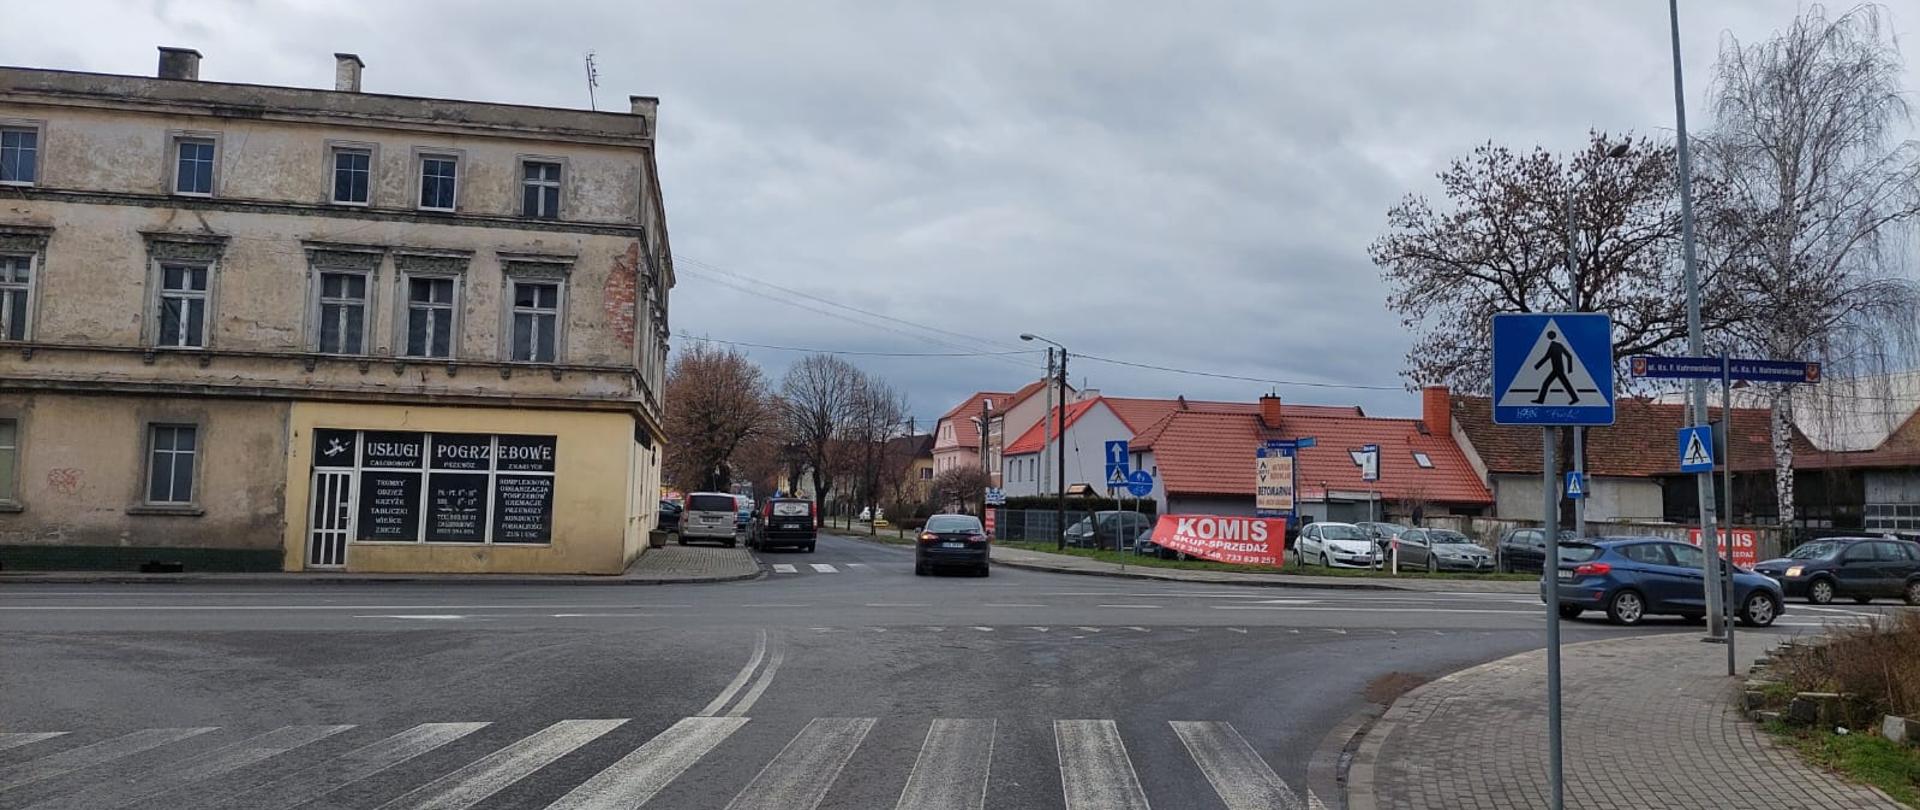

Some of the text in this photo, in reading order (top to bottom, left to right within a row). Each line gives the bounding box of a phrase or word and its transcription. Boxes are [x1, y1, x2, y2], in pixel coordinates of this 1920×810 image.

[368, 442, 552, 460] USŁUGI POGRZEBOWE
[1176, 518, 1268, 542] KOMIS
[1173, 534, 1269, 553] SKUP-SPRZEDAŻ
